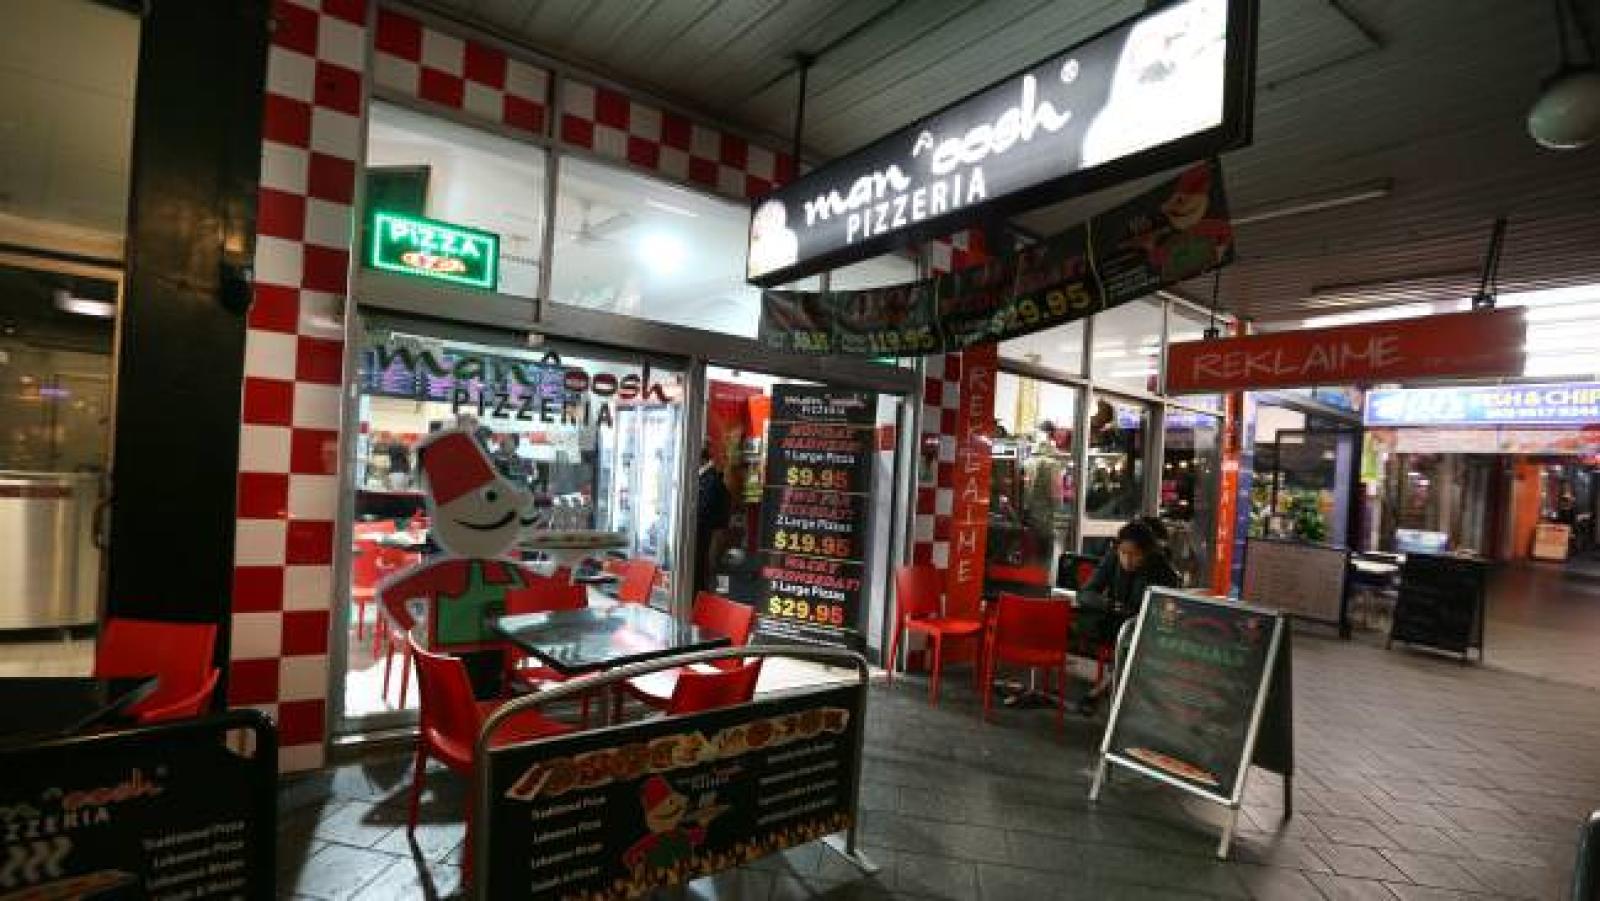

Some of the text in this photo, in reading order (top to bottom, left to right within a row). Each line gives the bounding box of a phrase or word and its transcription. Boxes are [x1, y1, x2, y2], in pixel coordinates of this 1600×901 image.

[846, 167, 987, 244] PIZZERIA
[388, 218, 482, 258] PIZZA
[1193, 335, 1402, 380] REKLAIME
[453, 390, 614, 427] PIZZERIA
[792, 450, 823, 463] Large
[787, 466, 849, 489] $9.95
[785, 516, 816, 530] Large
[774, 529, 850, 556] $19.95
[780, 581, 811, 597] Large
[768, 596, 844, 628] $29.95
